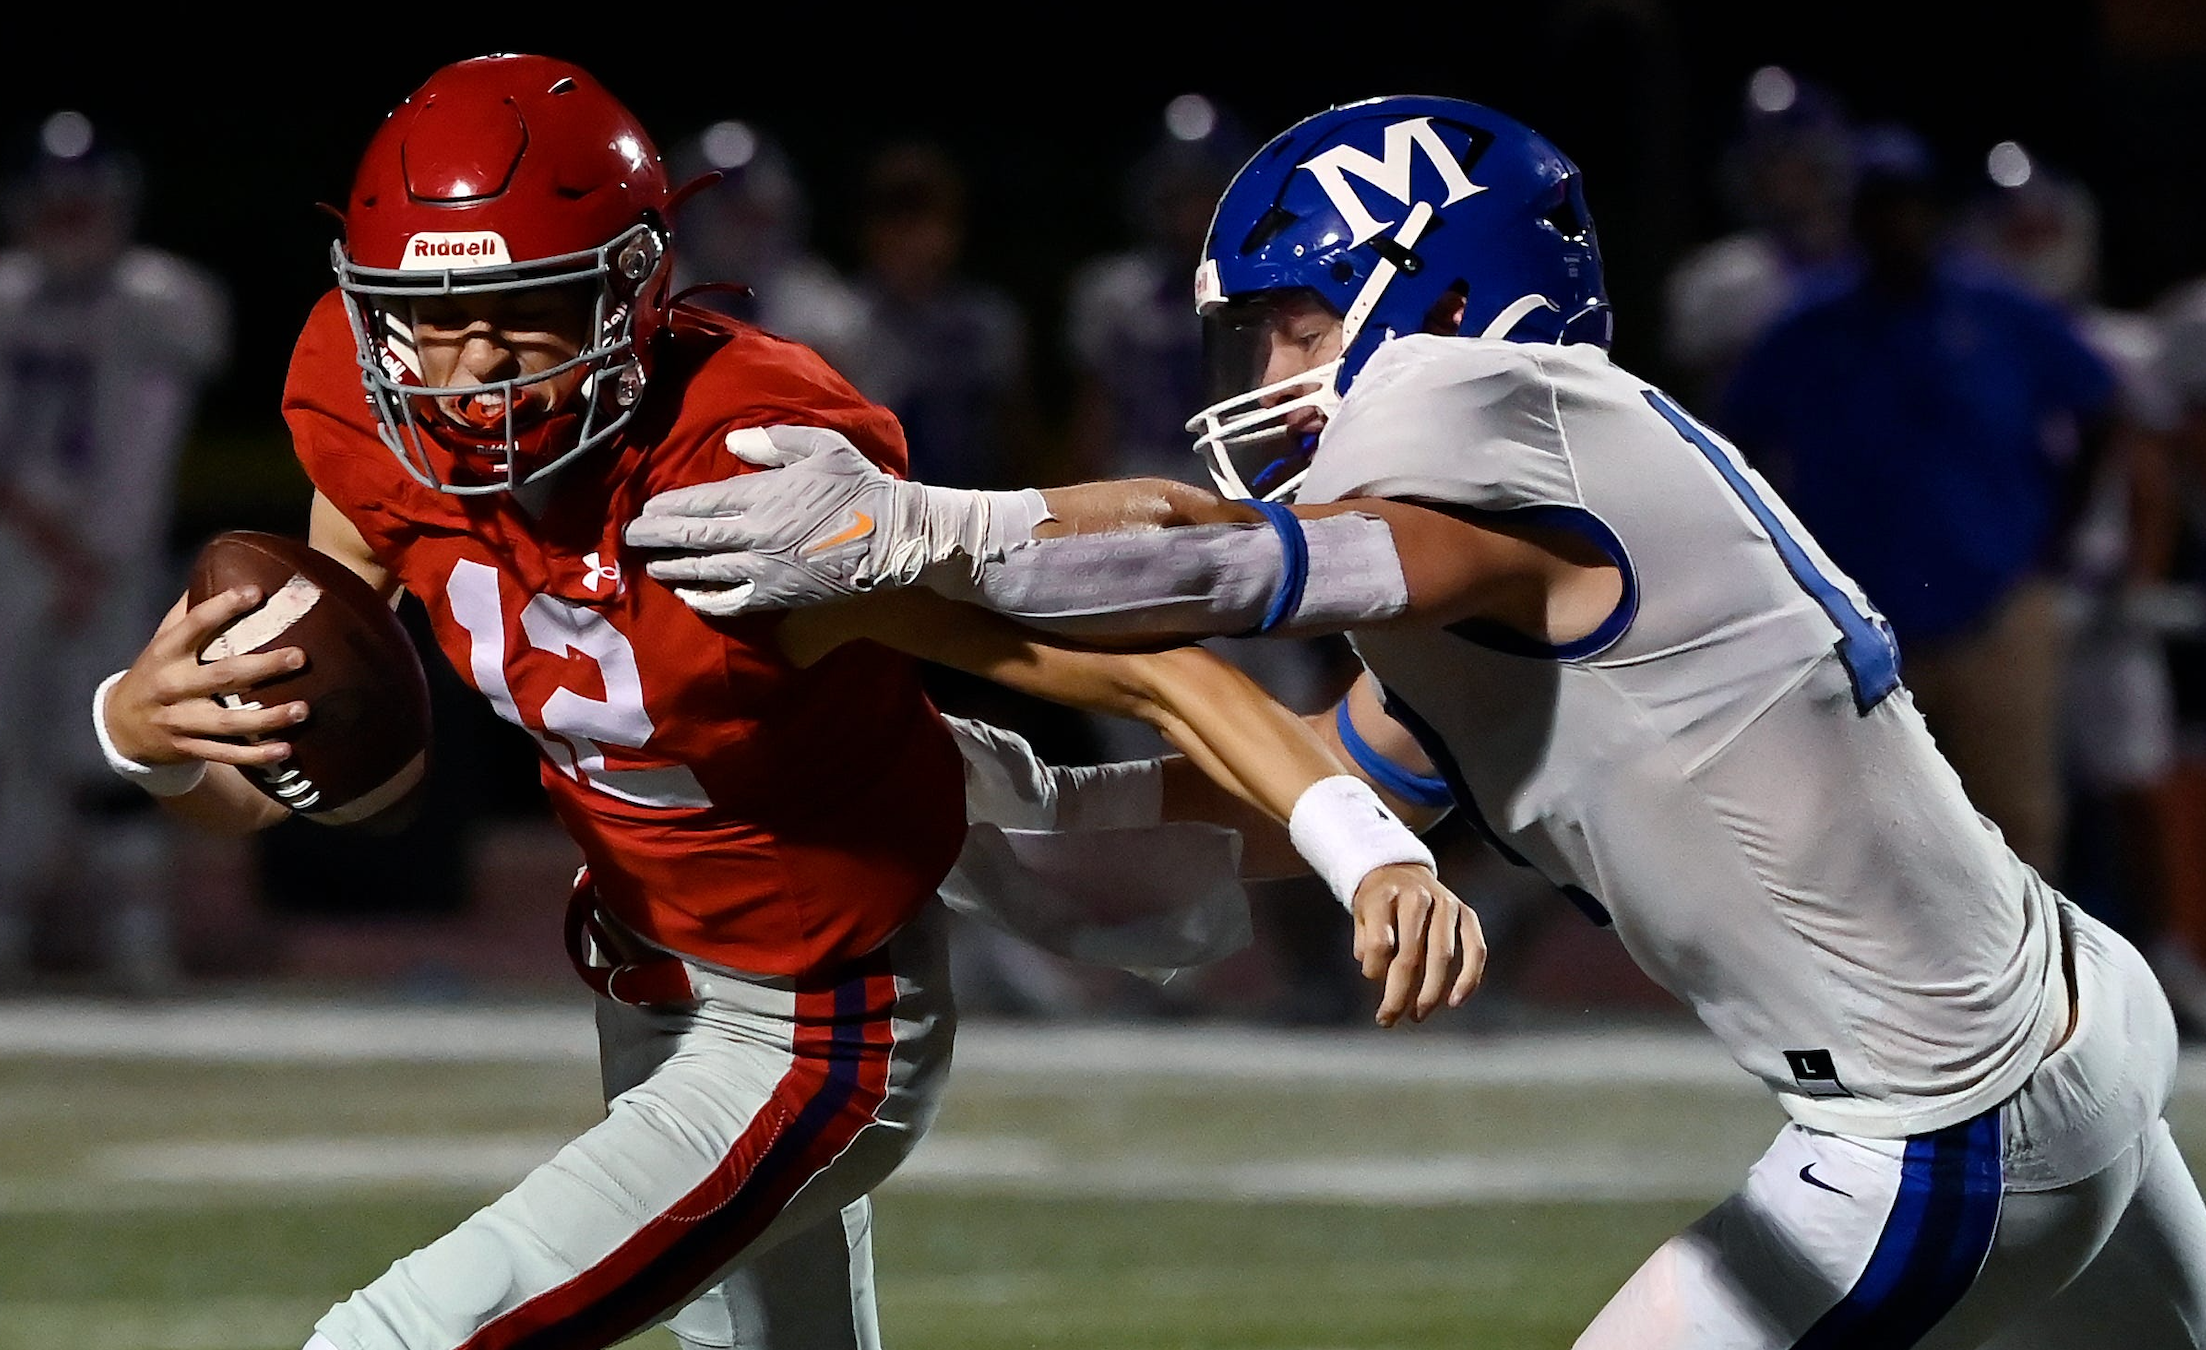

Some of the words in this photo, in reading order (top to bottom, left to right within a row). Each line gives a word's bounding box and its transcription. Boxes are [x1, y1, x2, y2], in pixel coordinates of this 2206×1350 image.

[414, 238, 496, 257] Riddell
[1297, 116, 1489, 250] M
[446, 557, 714, 808] 12
